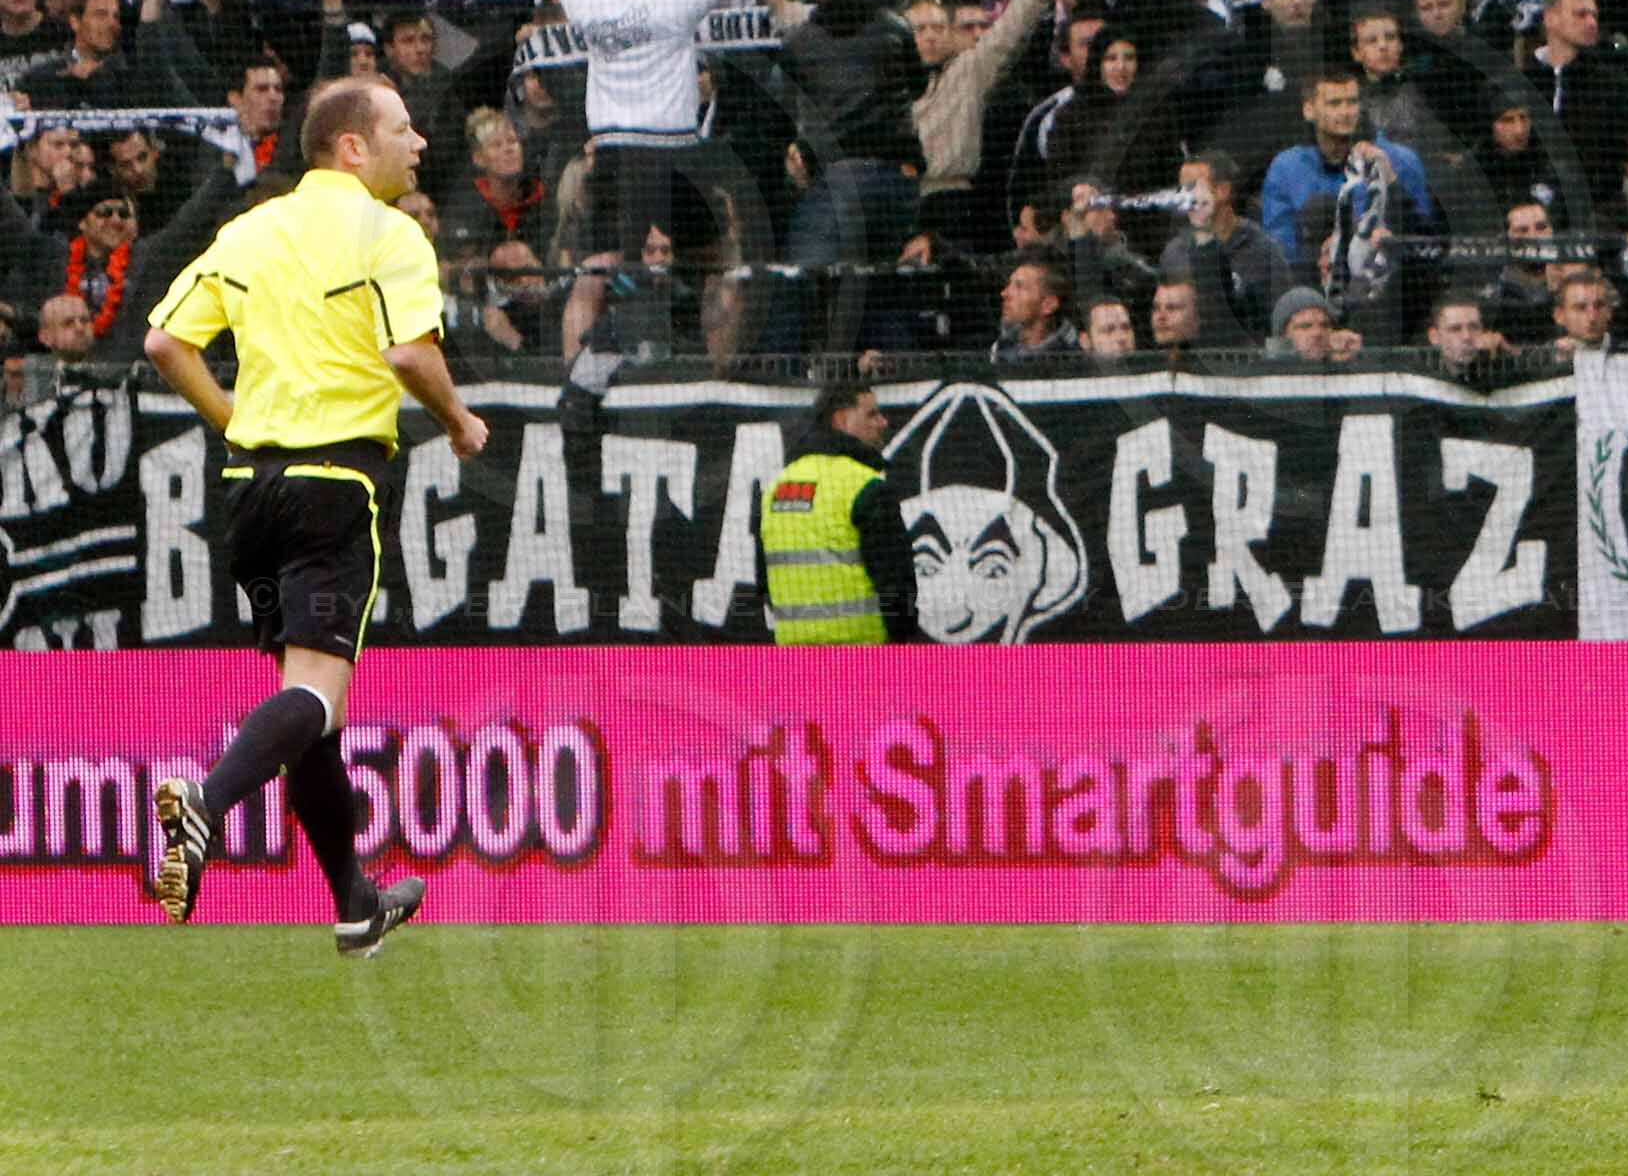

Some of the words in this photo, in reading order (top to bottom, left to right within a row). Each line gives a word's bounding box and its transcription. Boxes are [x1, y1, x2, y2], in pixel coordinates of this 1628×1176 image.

[1107, 412, 1546, 634] GRAZ
[339, 721, 600, 858] 5000
[641, 720, 822, 858] mit
[856, 714, 1549, 892] Smartguide
